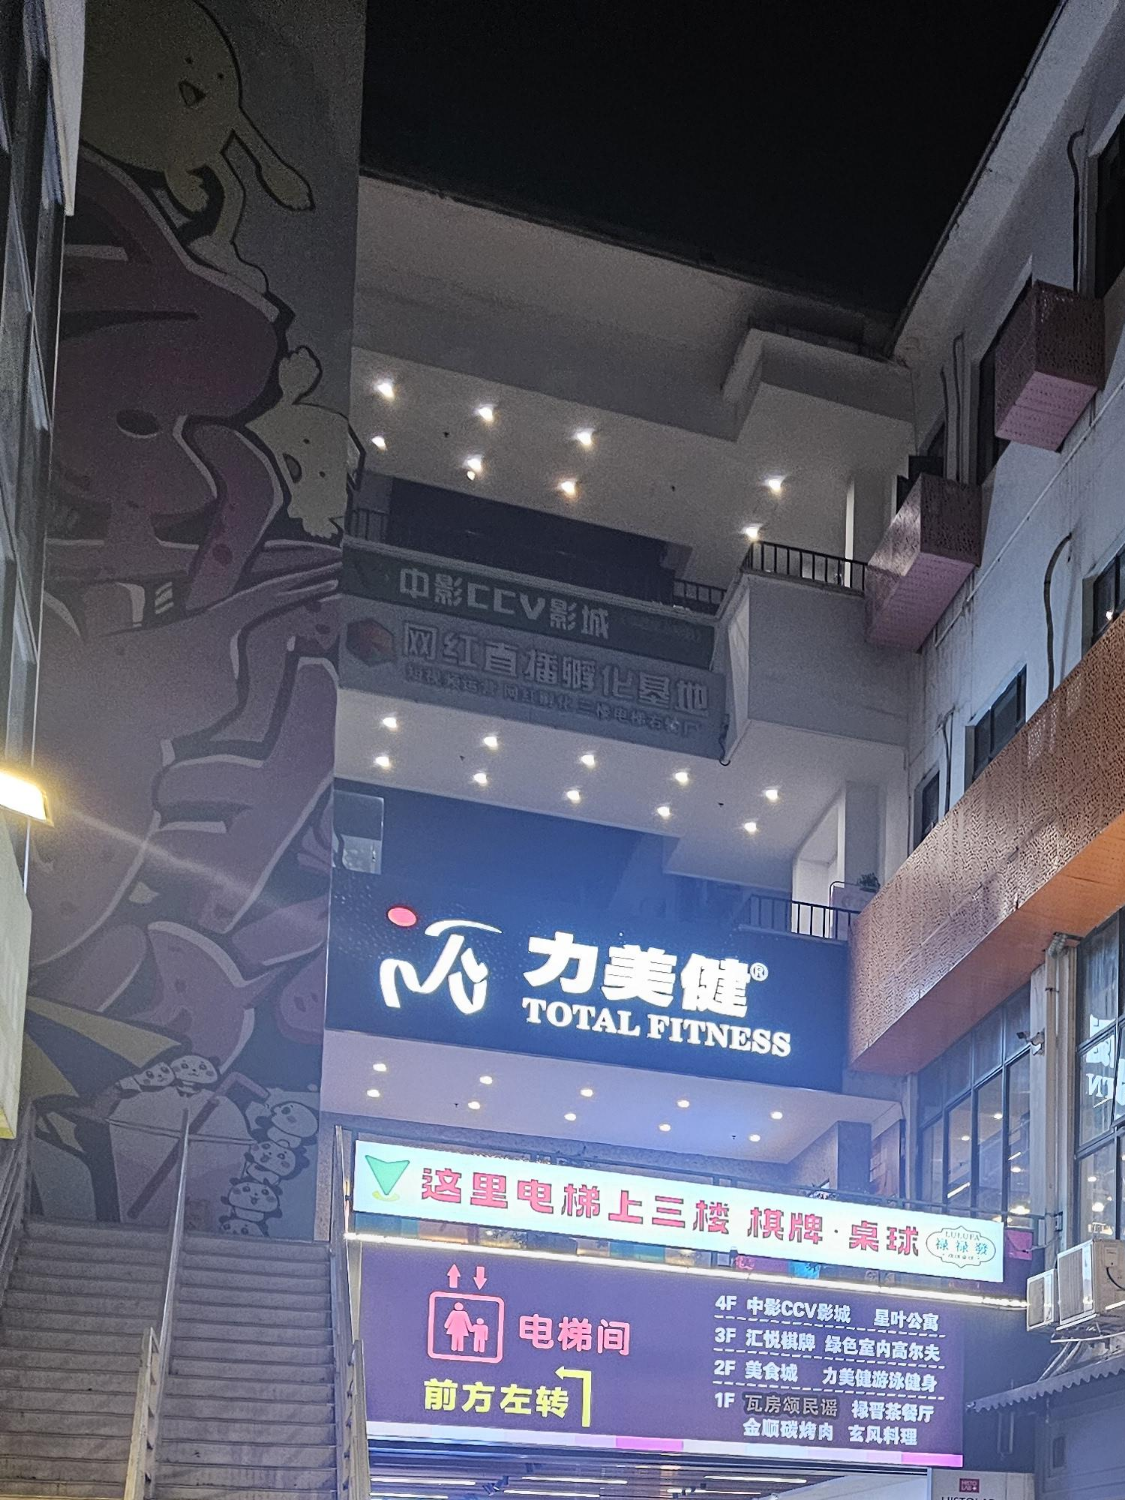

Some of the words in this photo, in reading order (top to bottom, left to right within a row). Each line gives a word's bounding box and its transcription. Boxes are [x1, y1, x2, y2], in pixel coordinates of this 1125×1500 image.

[400, 568, 609, 639] 中影CCV影城
[403, 622, 708, 715] 网红直播孵化基地
[522, 997, 640, 1036] TOTAL
[647, 1014, 791, 1057] FITNESS
[422, 1167, 729, 1234] 这里电梯上三楼
[715, 1296, 737, 1311] 4F
[746, 1297, 851, 1323] 中影CCV影城
[873, 1308, 939, 1331] 星叶公寓
[518, 1314, 631, 1356] 电梯间
[714, 1327, 737, 1343] 3F
[745, 1329, 816, 1351] 汇悦棋牌
[824, 1334, 941, 1362] 绿色室内高尔夫
[713, 1360, 736, 1375] 2F
[744, 1361, 798, 1382] 美食城
[822, 1367, 937, 1392] 力美健游泳健身
[424, 1377, 570, 1419] 前方左转
[714, 1392, 735, 1408] 1F
[745, 1394, 838, 1417] 瓦房颂民谣
[743, 1418, 834, 1441] 金顺碳烤肉
[848, 1425, 918, 1445] 玄风料理
